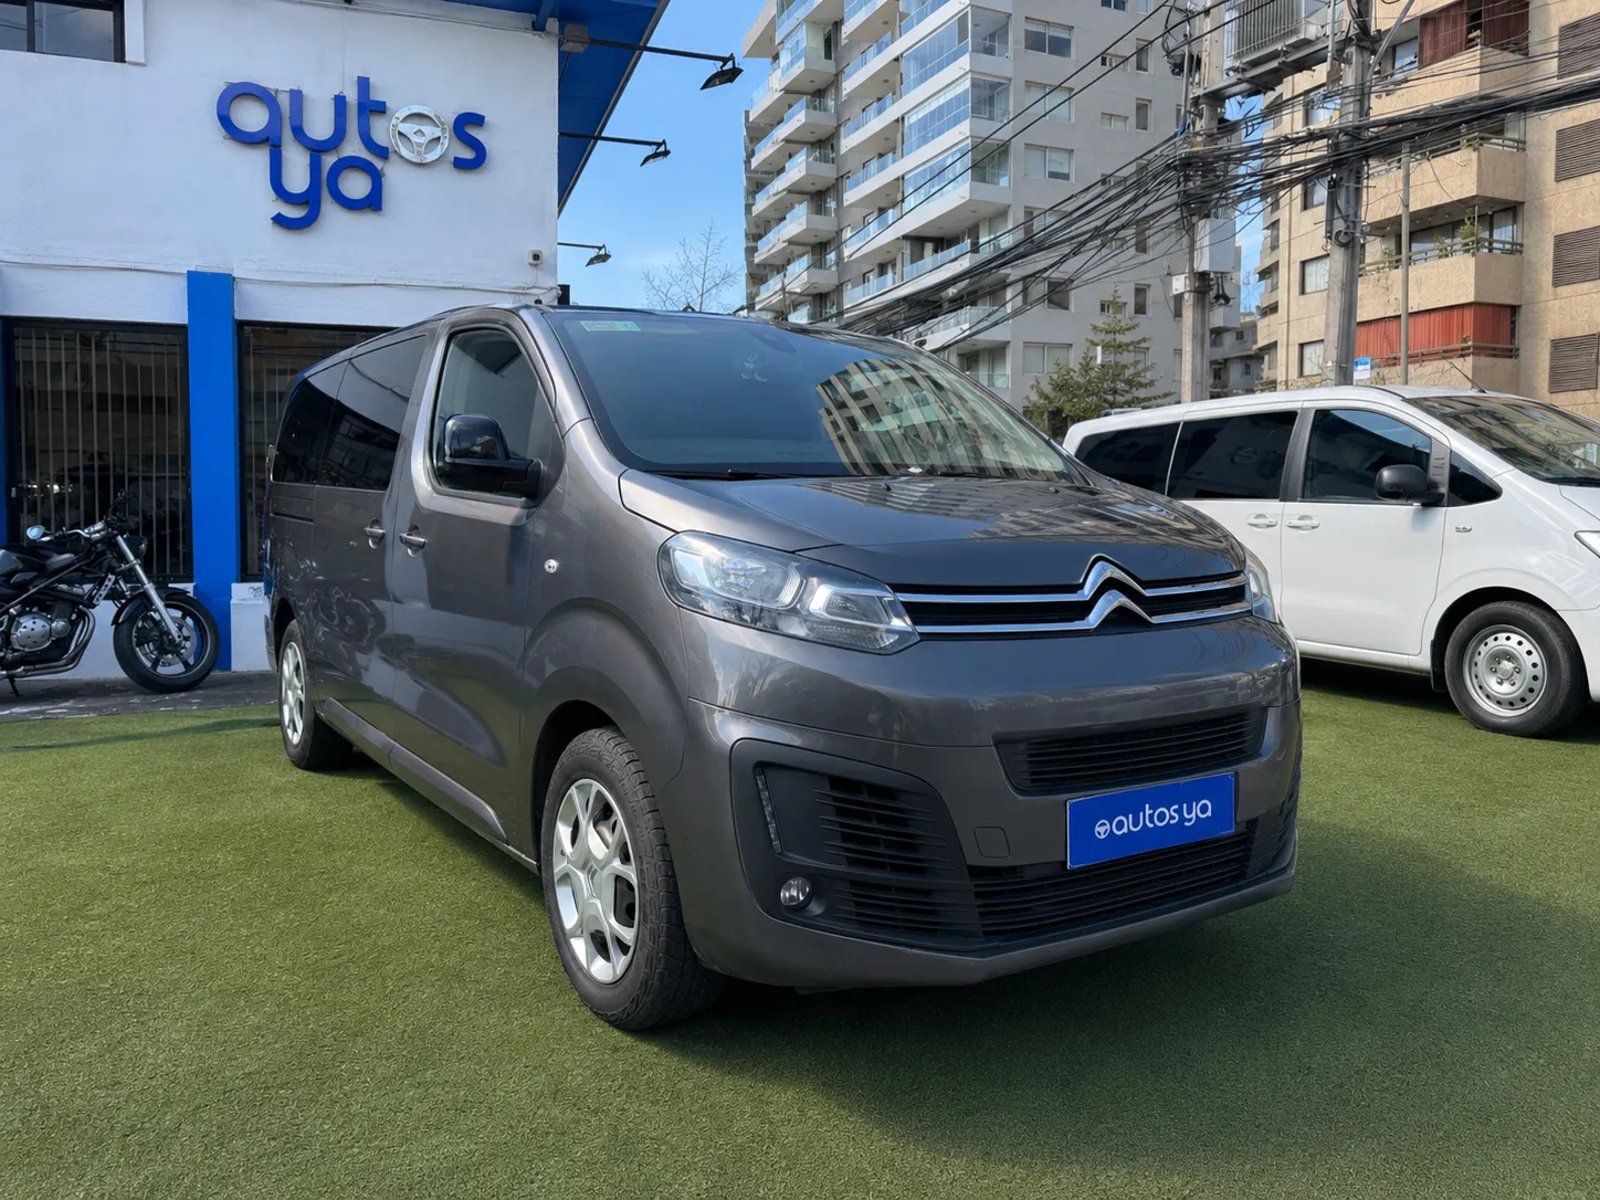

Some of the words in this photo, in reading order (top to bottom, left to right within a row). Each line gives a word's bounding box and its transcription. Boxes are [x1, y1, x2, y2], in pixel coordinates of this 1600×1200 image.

[216, 75, 487, 170] autos
[269, 147, 383, 230] ya
[1112, 803, 1179, 835] autos
[1183, 799, 1212, 826] ya
